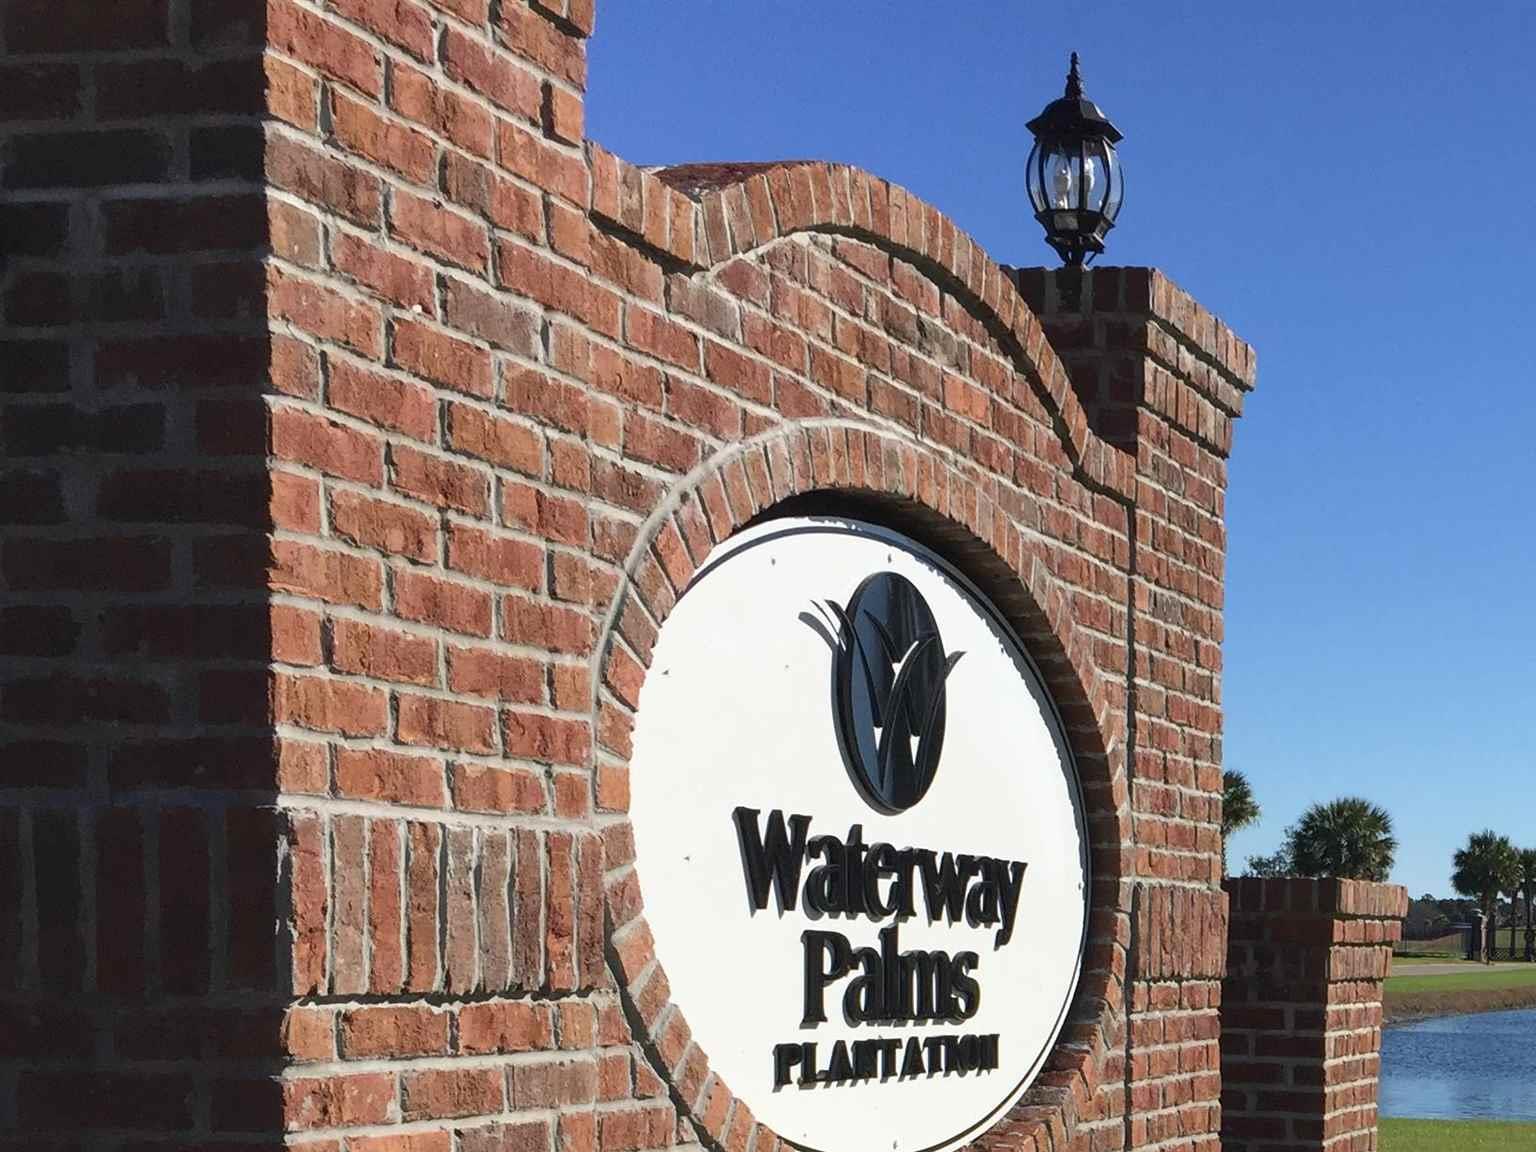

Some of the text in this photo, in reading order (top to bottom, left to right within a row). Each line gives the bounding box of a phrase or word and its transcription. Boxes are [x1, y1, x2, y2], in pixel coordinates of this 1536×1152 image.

[732, 806, 1027, 949] Waterway
[799, 924, 980, 1029] Palms
[772, 1033, 1000, 1091] PLANTATION
